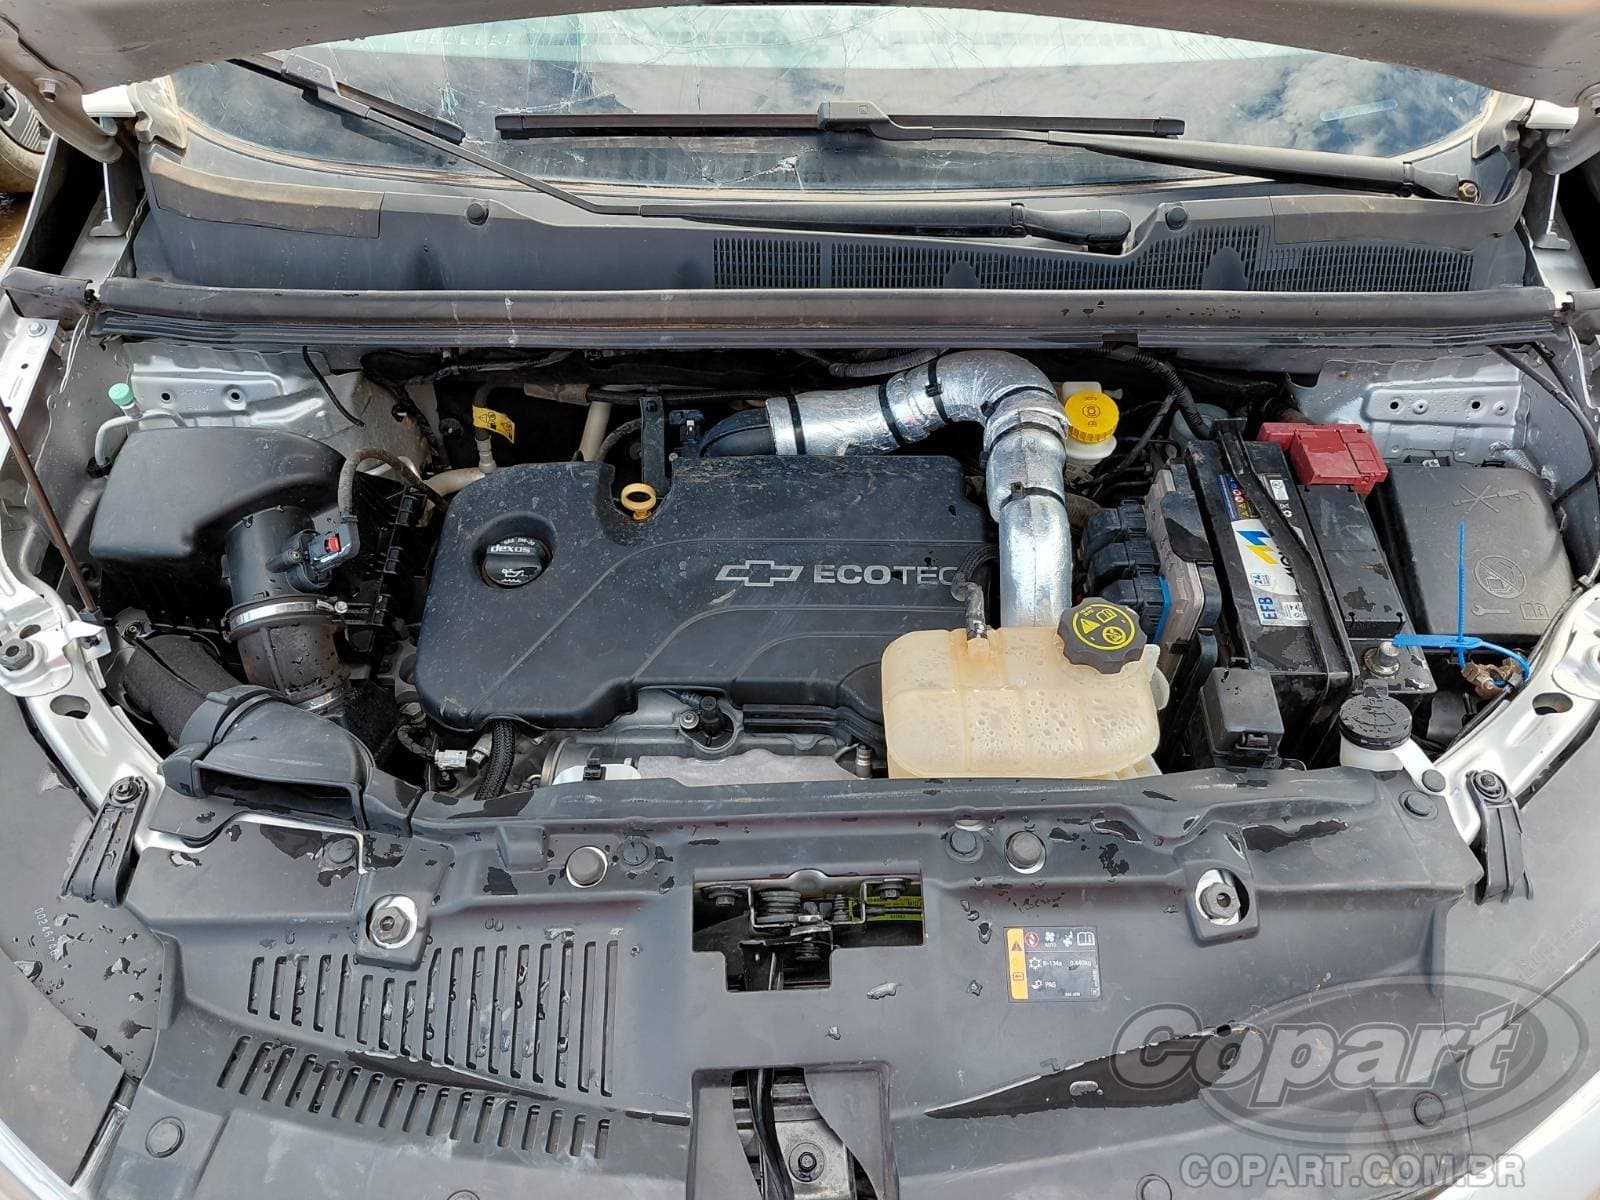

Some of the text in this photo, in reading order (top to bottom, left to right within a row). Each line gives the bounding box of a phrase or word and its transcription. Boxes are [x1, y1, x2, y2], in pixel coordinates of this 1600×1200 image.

[490, 544, 531, 553] dexos
[814, 564, 959, 585] ECOTEC
[1257, 596, 1278, 620] EFB
